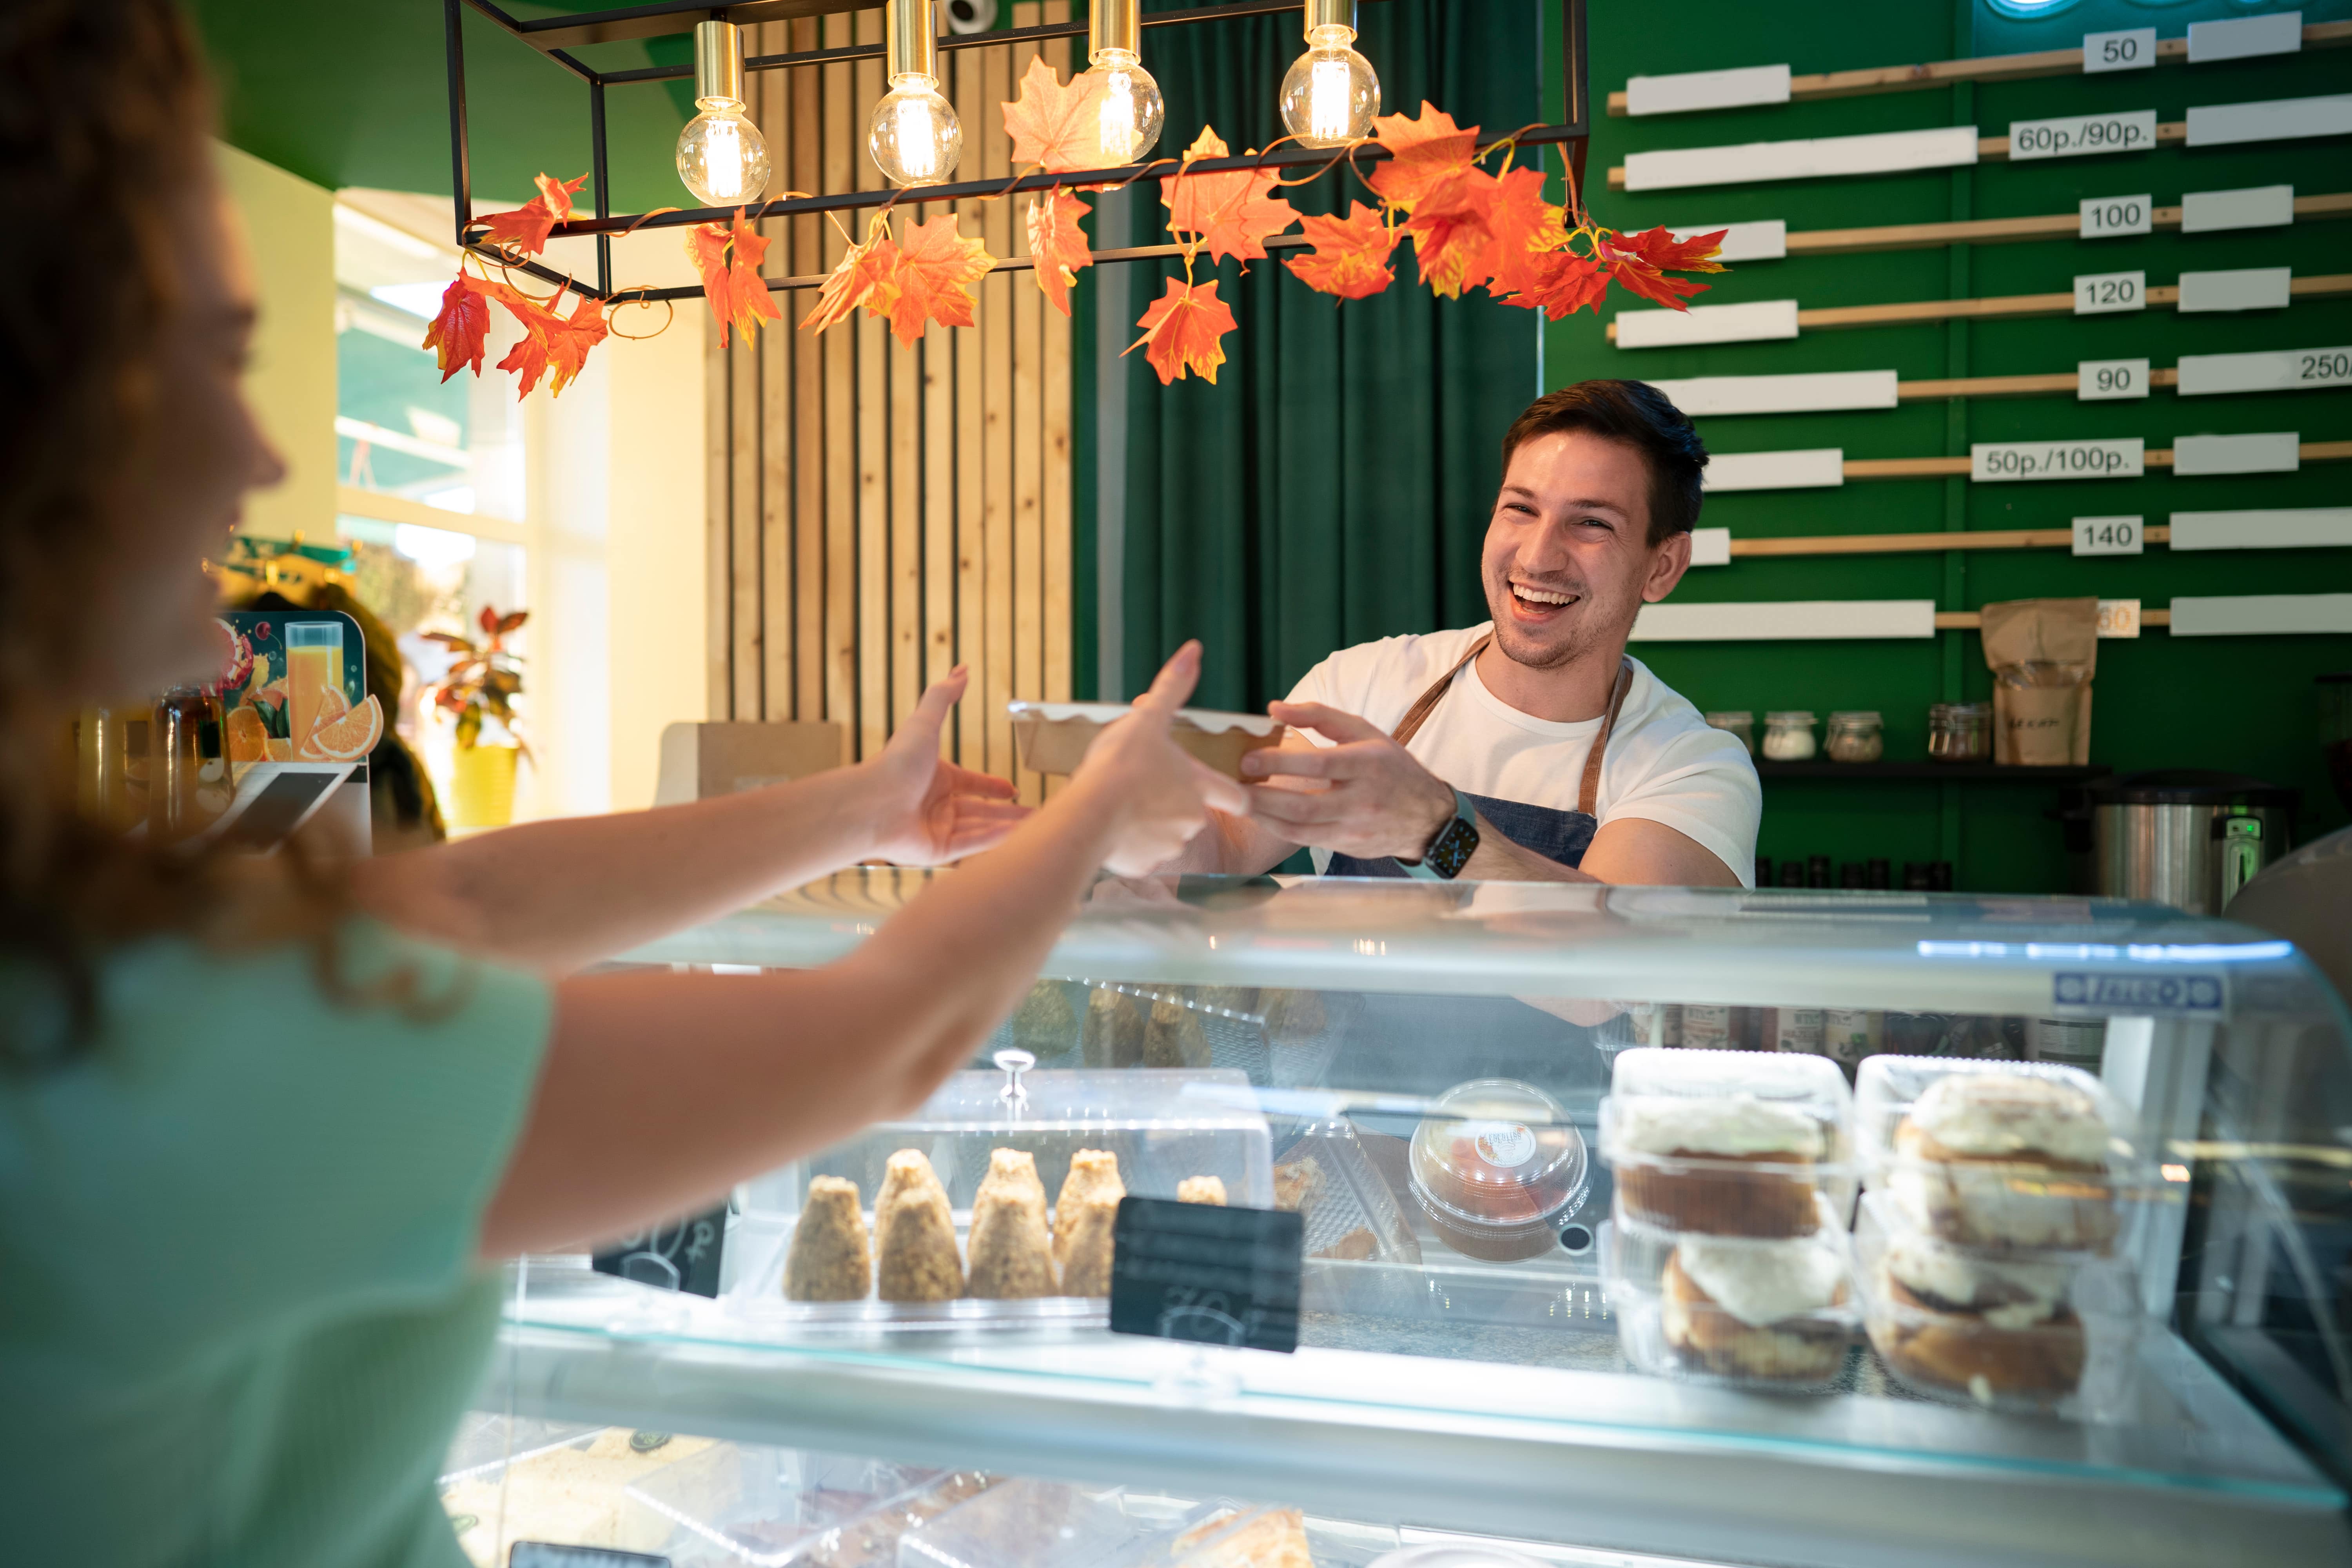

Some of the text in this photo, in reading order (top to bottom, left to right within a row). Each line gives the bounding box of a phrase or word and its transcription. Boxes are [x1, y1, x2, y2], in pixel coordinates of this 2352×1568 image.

[2103, 38, 2138, 63] 50
[2091, 203, 2141, 228] 100
[2085, 279, 2135, 304] 120
[2097, 367, 2131, 391] 90
[2083, 522, 2133, 547] 140
